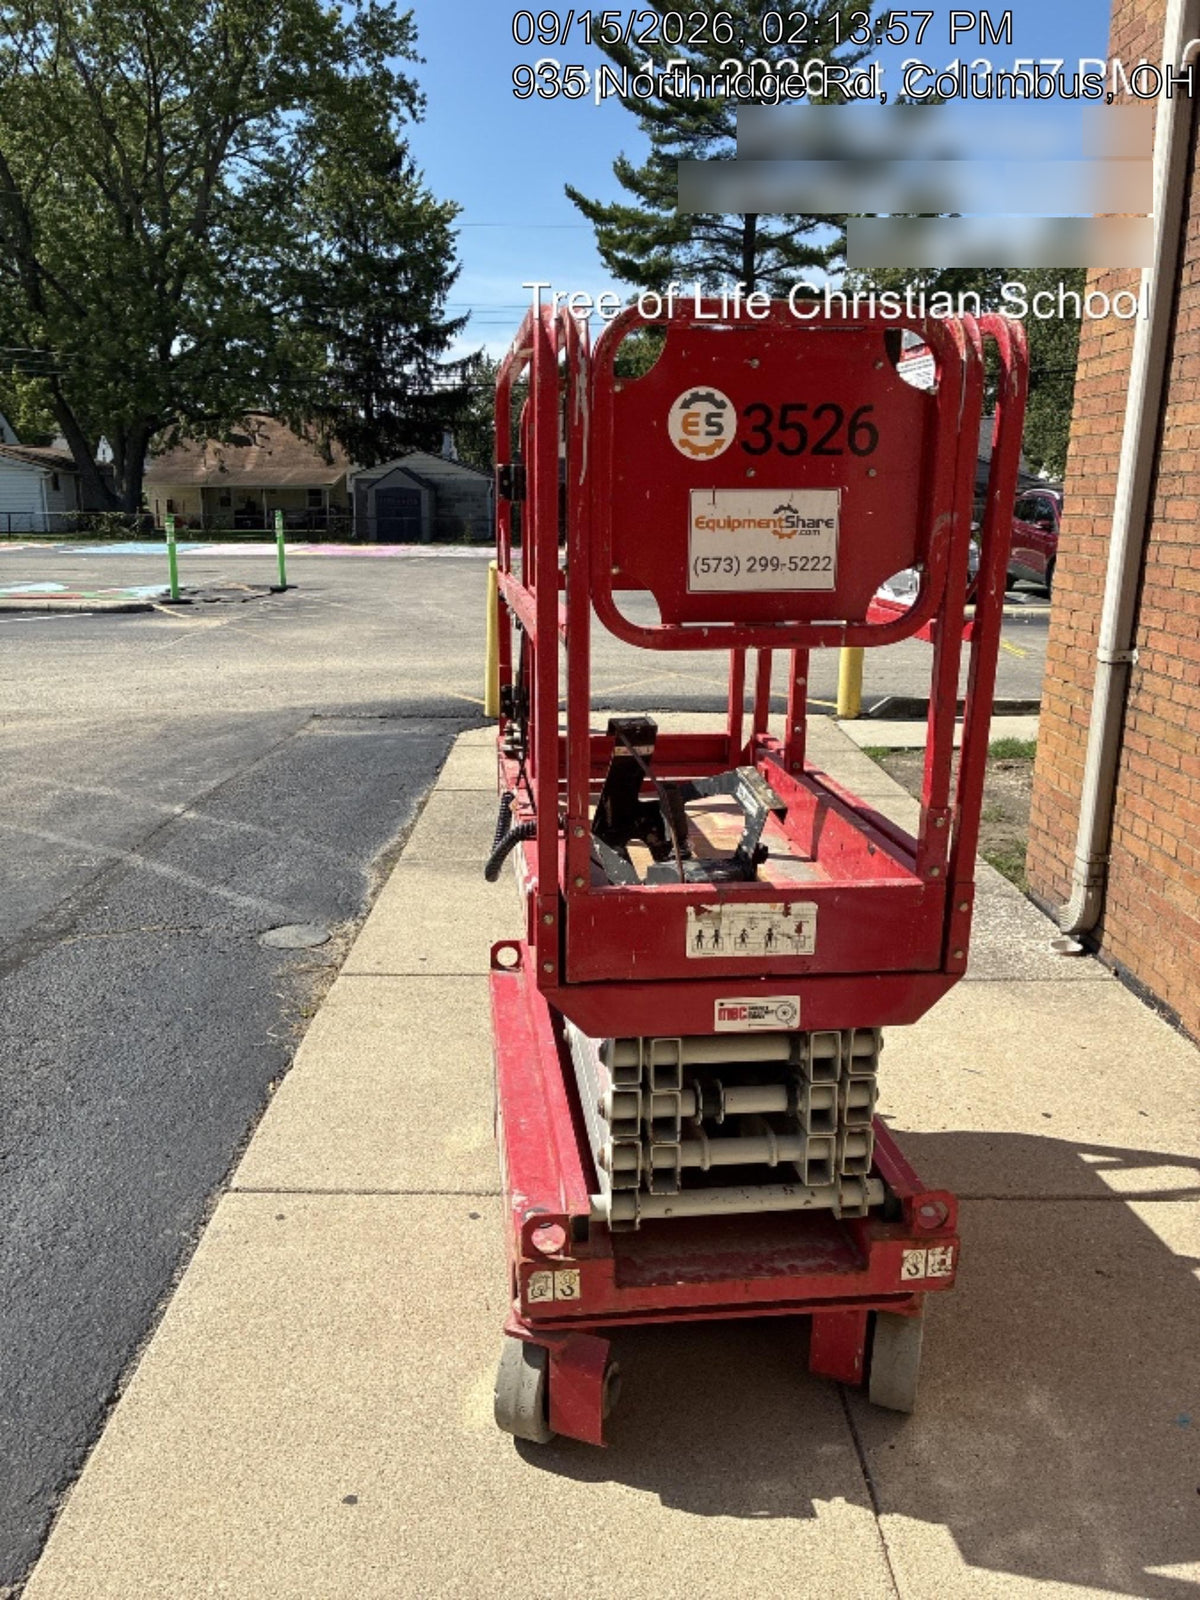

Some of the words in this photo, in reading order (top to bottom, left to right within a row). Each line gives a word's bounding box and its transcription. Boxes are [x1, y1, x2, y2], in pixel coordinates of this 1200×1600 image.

[741, 403, 879, 456] 3526
[694, 514, 834, 532] EquipmentShare
[693, 556, 741, 577] (573)
[746, 556, 832, 573] 299-5222
